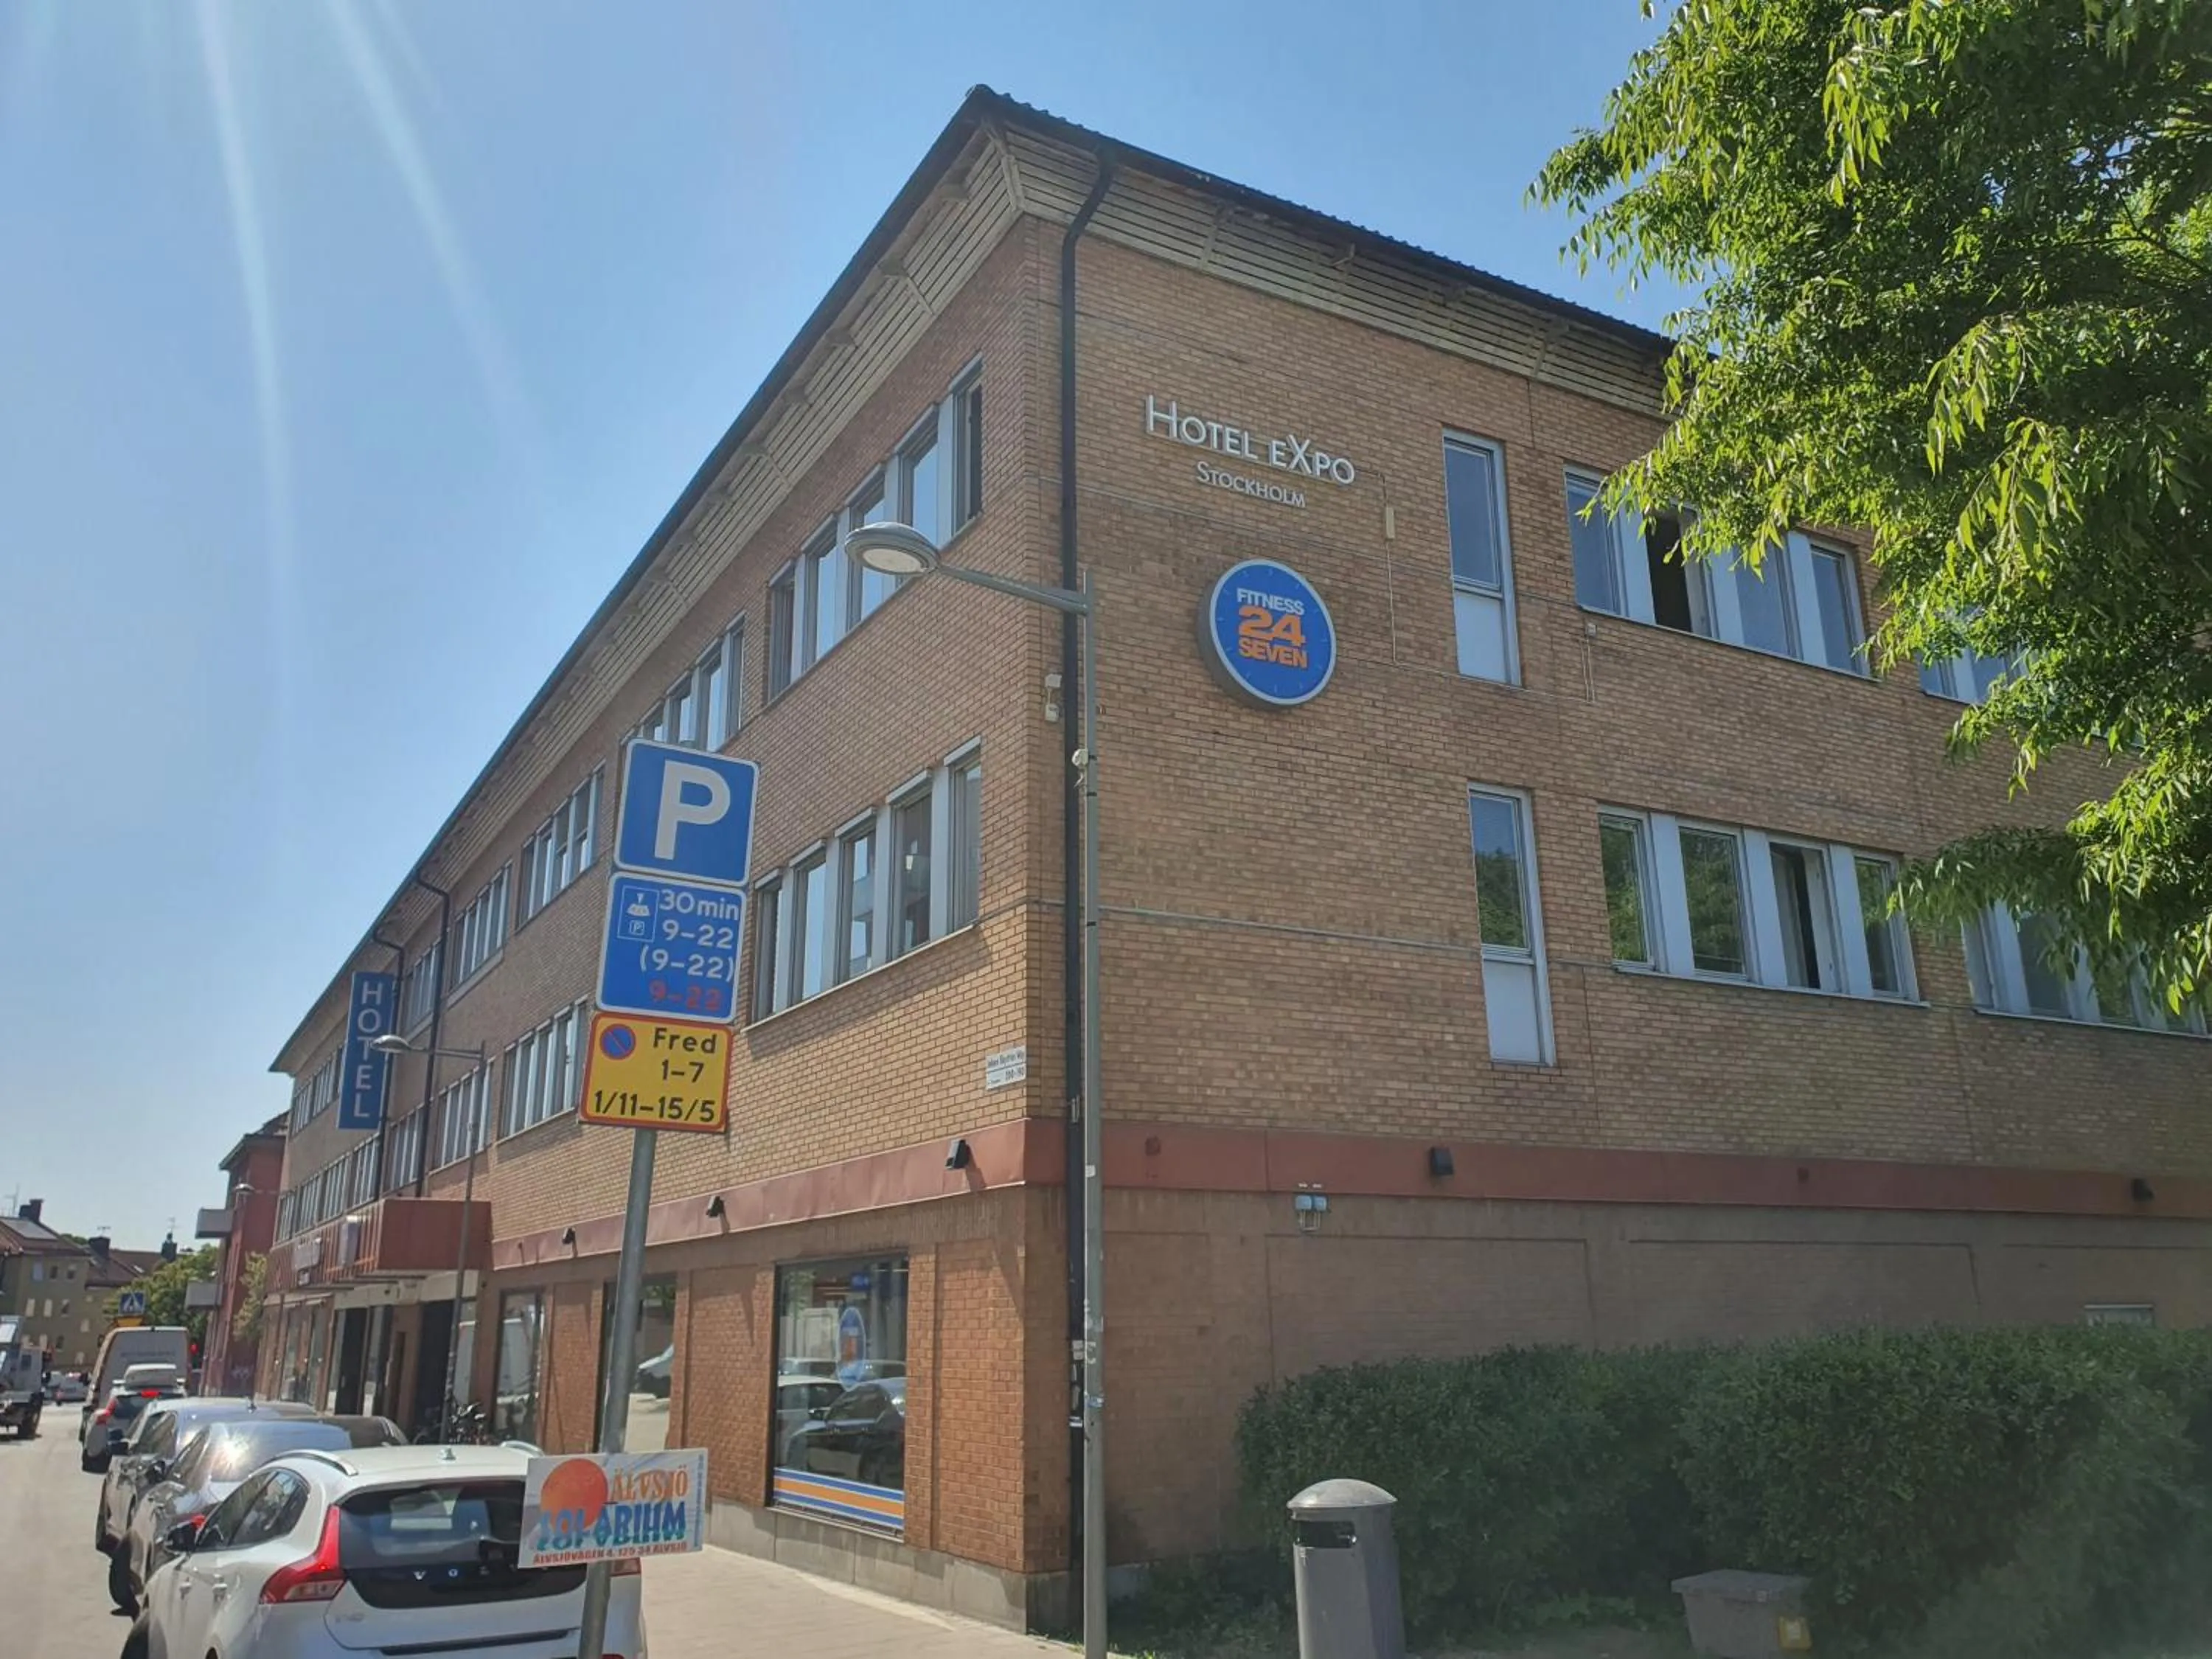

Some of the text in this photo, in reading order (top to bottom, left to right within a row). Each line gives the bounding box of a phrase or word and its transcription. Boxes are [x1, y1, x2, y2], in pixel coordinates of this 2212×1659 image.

[1145, 394, 1259, 461] HOTEL
[1196, 460, 1307, 509] STOCKHOLM
[1237, 587, 1305, 616] FITNESS
[1237, 605, 1306, 647] 24
[1238, 637, 1308, 668] SEVEN
[654, 759, 731, 861] P
[661, 919, 734, 950] 9-22
[639, 945, 736, 983] (9-22)
[650, 980, 723, 1012] 9-22
[354, 981, 382, 1118] HOTEL
[653, 1027, 717, 1054] Fred
[661, 1060, 705, 1083] 1-7
[594, 1090, 716, 1123] 1/11-15/5
[611, 1465, 689, 1501] ÄLVSJÖ
[536, 1501, 686, 1551] SOLARIUM
